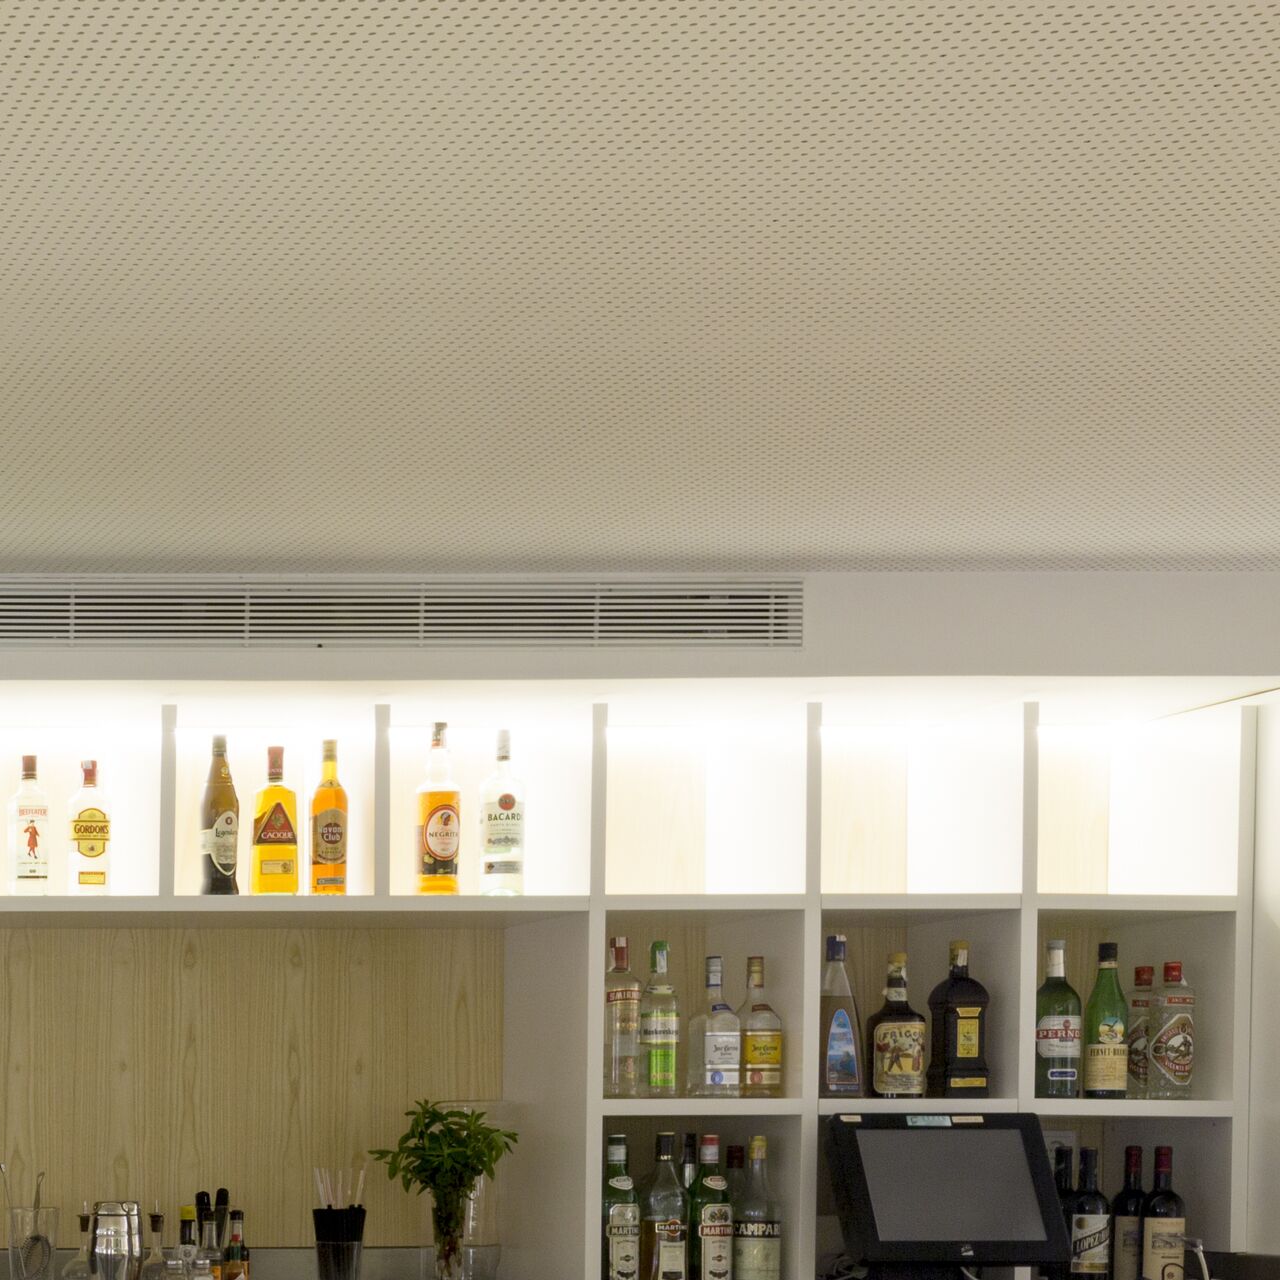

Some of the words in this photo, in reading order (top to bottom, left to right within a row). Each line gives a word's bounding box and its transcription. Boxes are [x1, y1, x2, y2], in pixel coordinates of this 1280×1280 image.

[18, 807, 48, 817] BEEFEATER
[74, 823, 110, 835] GORDON'S
[261, 831, 294, 839] CACIQUE
[323, 833, 341, 841] Club
[1076, 1233, 1099, 1253] LOPEZ
